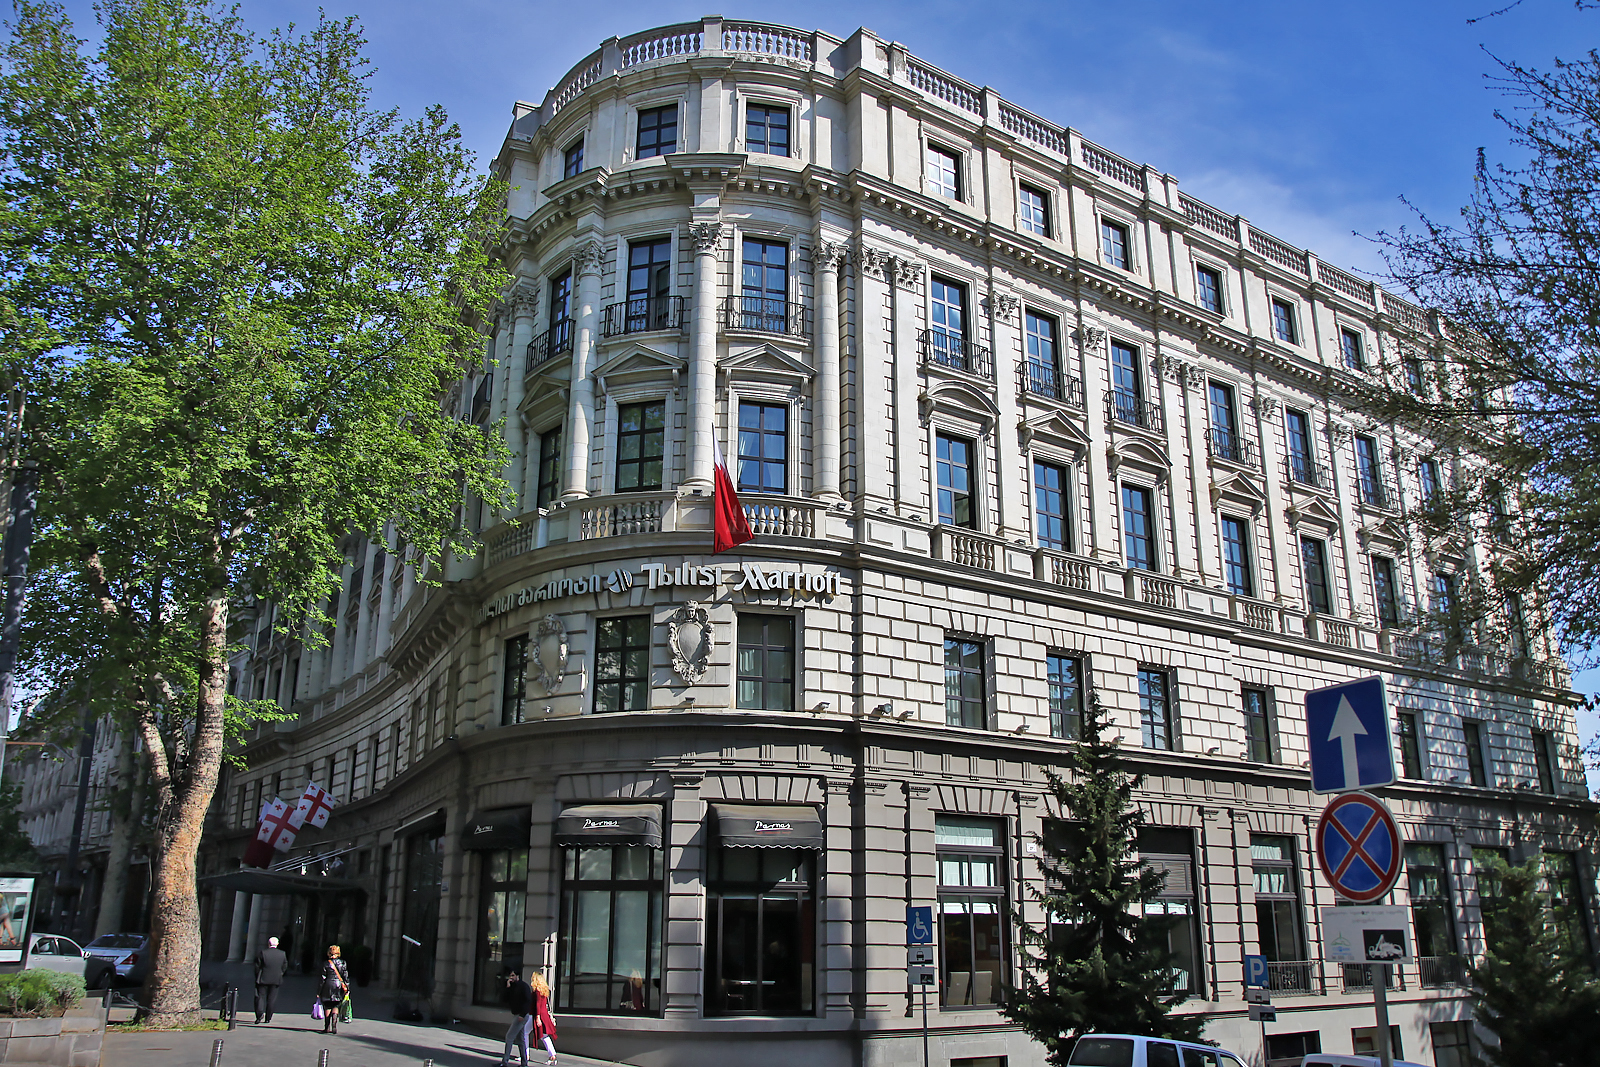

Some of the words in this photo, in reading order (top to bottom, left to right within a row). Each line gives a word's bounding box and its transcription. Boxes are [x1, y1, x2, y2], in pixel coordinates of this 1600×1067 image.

[640, 561, 723, 590] Tbilisi
[733, 564, 841, 596] Marriott
[582, 818, 620, 829] Parnas
[754, 820, 794, 831] Parnas
[1249, 958, 1264, 984] P
